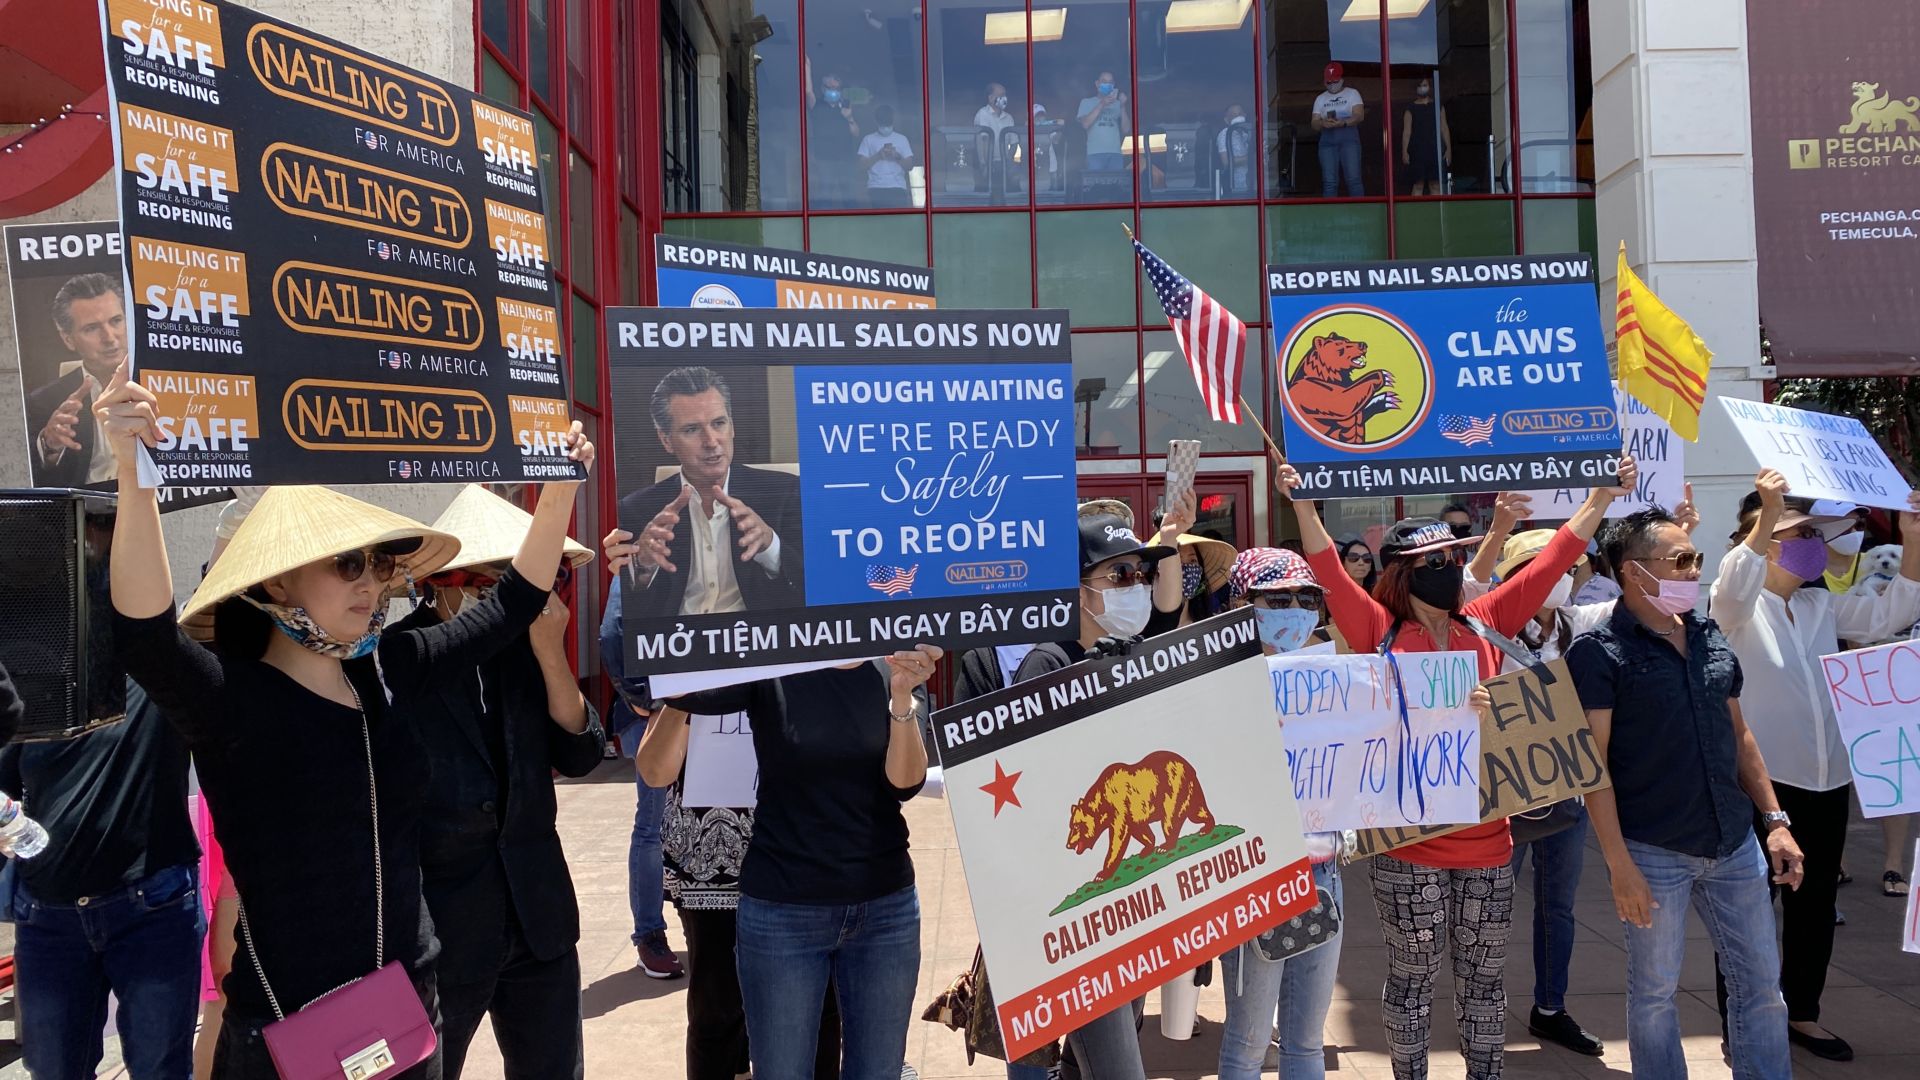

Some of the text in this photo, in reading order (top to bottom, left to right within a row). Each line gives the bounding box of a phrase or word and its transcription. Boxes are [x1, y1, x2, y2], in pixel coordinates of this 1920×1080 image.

[143, 7, 171, 29] for
[173, 22, 184, 33] a
[198, 5, 214, 24] IT
[121, 19, 216, 78] SAFE
[124, 54, 217, 87] SENSIBLE & RESPONSIBLE
[260, 36, 448, 134] NAILING IT
[125, 66, 220, 105] REOPENING
[127, 109, 228, 149] NAILING IT
[475, 105, 531, 136] NAILING IT
[157, 136, 197, 160] for a
[396, 140, 465, 175] AMERICA
[482, 136, 533, 176] SAFE
[1826, 136, 1920, 154] PECHAN
[1827, 156, 1892, 168] RESORT
[135, 152, 229, 204] SAFE
[486, 171, 537, 197] REOPENING
[137, 188, 230, 213] SENSIBLE & RESPONSIBLE
[275, 156, 460, 237] NAILING IT
[138, 200, 233, 230] REOPENING
[488, 203, 543, 230] NAILING IT
[1821, 209, 1920, 224] PECHANGA.C
[19, 233, 121, 260] REOPE
[1829, 227, 1918, 240] TEMECULA,
[138, 242, 240, 273] NAILING IT
[408, 248, 477, 276] AMERICA
[495, 234, 545, 271] SAFE
[167, 265, 209, 291] for a
[498, 270, 548, 292] REOPENING
[663, 244, 930, 291] REOPEN NAIL SALONS NOW
[1270, 260, 1588, 290] REOPEN NAIL SALONS NOW
[146, 284, 239, 328] SAFE
[286, 275, 472, 339] NAILING IT
[500, 301, 554, 323] NAILING IT
[1496, 297, 1528, 324] the
[147, 321, 240, 337] SENSIBLE & RESPONSIBLE
[148, 332, 243, 355] REOPENING
[618, 322, 1062, 348] REOPEN NAIL SALONS NOW
[1447, 326, 1577, 358] CLAWS
[506, 332, 556, 364] SAFE
[420, 354, 489, 377] AMERICA
[510, 368, 559, 384] REOPENING
[1456, 362, 1583, 387] ARE OUT
[147, 375, 250, 397] NAILING IT
[811, 378, 1064, 404] ENOUGH WAITING
[177, 394, 218, 421] for a
[296, 394, 484, 441] NAILING IT
[512, 399, 565, 416] NAILING IT
[1508, 411, 1608, 430] NAILING IT
[156, 416, 249, 452] SAFE
[519, 430, 569, 456] SAFE
[818, 419, 1060, 454] WE'RE READY
[1576, 433, 1618, 442] AMERICA
[1621, 428, 1669, 462] ARN
[156, 452, 249, 461] SENSIBLE & RESPONSIBLE
[1768, 430, 1808, 457] LET
[1835, 439, 1887, 470] EARN
[158, 464, 252, 479] REOPENING
[431, 460, 501, 478] AMERICA
[523, 465, 577, 477] REOPENING
[1295, 454, 1621, 491] MỞ TIỆM NAIL NGAY BÂY GIỜ
[1802, 463, 1888, 496] A LIVING
[880, 450, 1011, 522] Safely
[831, 519, 1046, 558] TO REOPEN
[950, 564, 1023, 580] NAILING IT
[636, 598, 1073, 660] MỞ TIỆM NAIL NGAY BÂY GIỜ
[943, 618, 1256, 748] REOPEN NAIL SALONS NOW
[1272, 656, 1477, 716] REOPEN NAL SALON
[1285, 742, 1344, 801] IGHT
[1359, 737, 1388, 793] TO
[1043, 883, 1167, 965] CALIFORNIA
[1176, 836, 1266, 902] REPUBLIC
[1011, 869, 1311, 1041] MỞ TIỆM NAIL NGAY BÂY GIỜ
